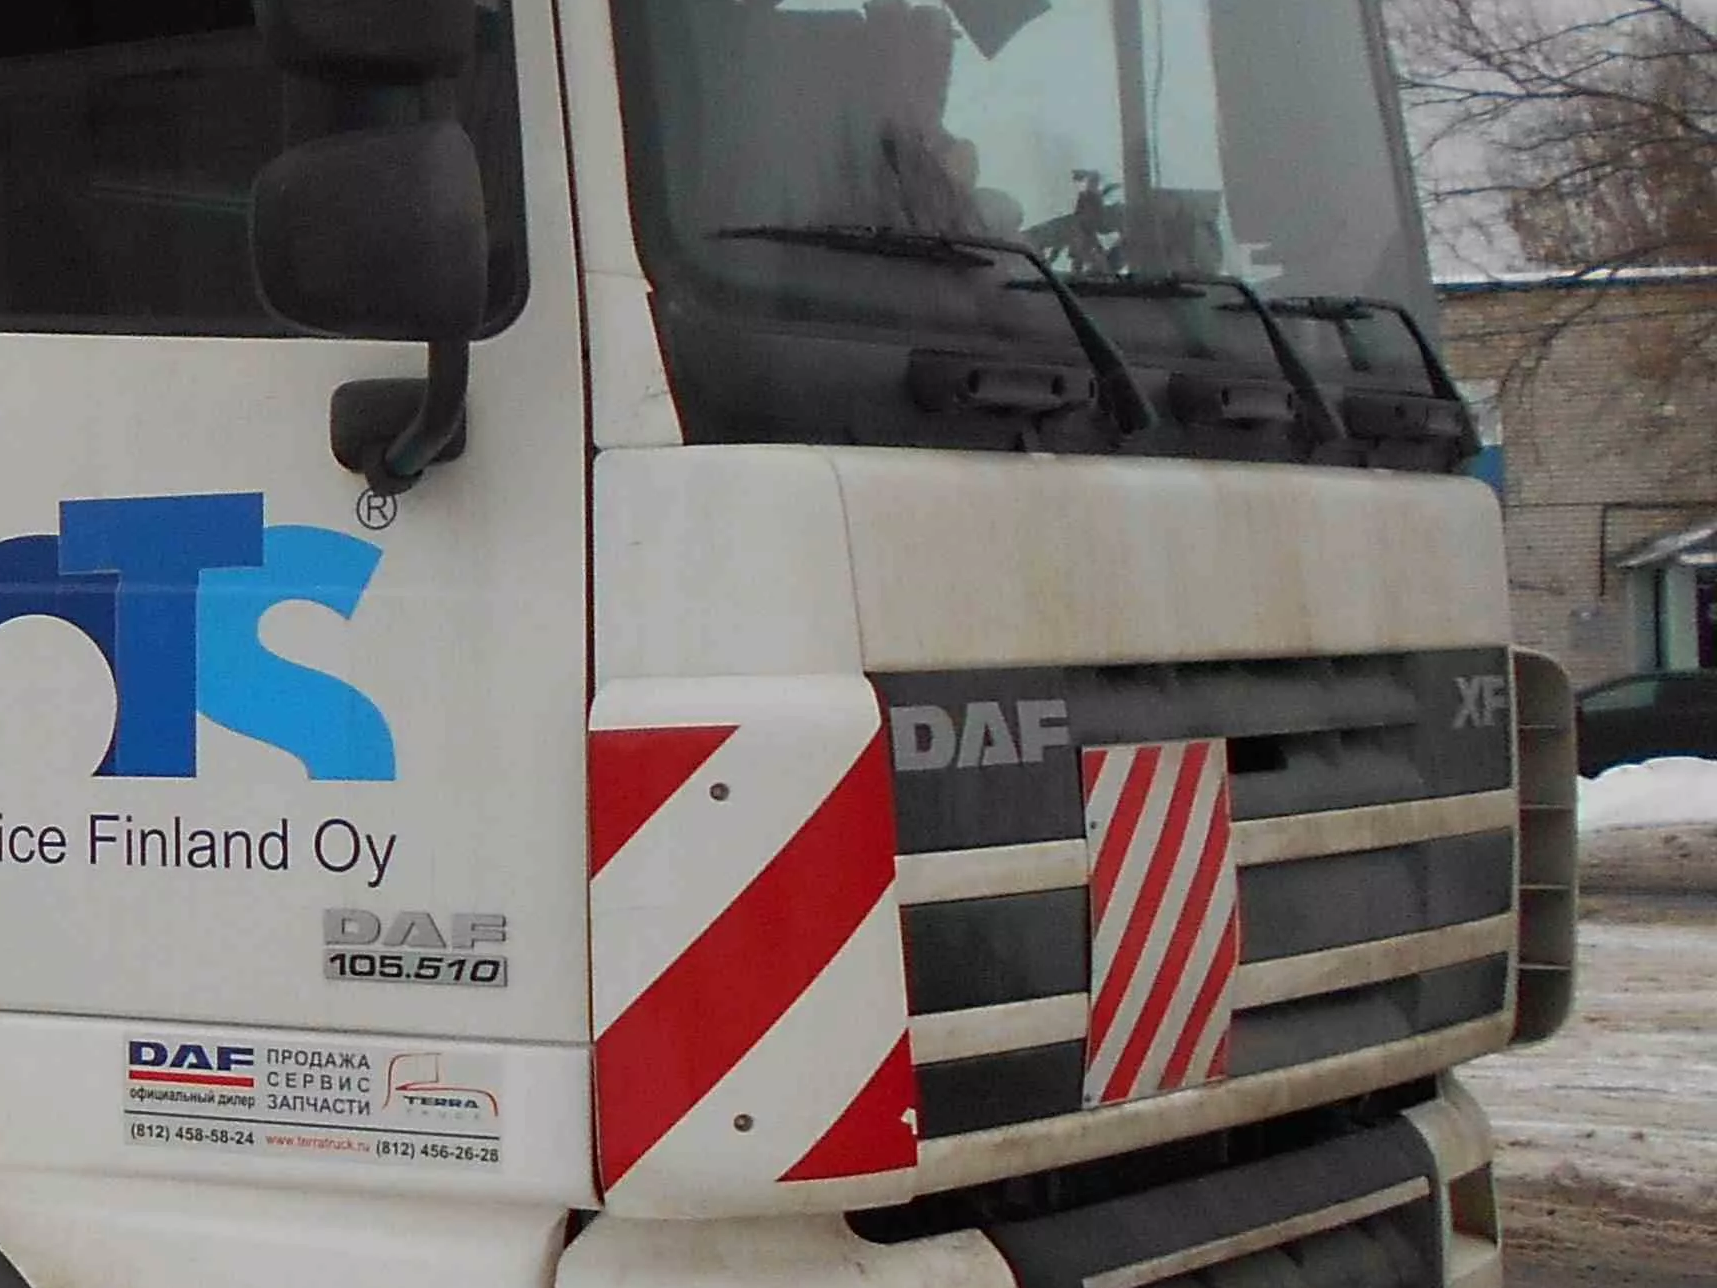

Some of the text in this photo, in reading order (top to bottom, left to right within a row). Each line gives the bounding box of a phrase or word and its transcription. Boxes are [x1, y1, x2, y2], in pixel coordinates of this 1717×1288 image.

[1452, 674, 1509, 729] XF
[890, 699, 1071, 771] DAF
[88, 813, 289, 870] Finland
[314, 818, 397, 888] Oy
[323, 909, 507, 948] DAF
[329, 953, 501, 982] 105.510
[129, 1041, 254, 1071] DAF
[267, 1049, 370, 1070] ПРОДАЖА
[267, 1072, 370, 1093] СЕРВИС
[130, 1087, 255, 1109] официальный дилер
[267, 1095, 370, 1116] ЗАПЧАСТИ
[131, 1123, 255, 1145] (812) 458-58-24
[376, 1139, 415, 1160] (812)
